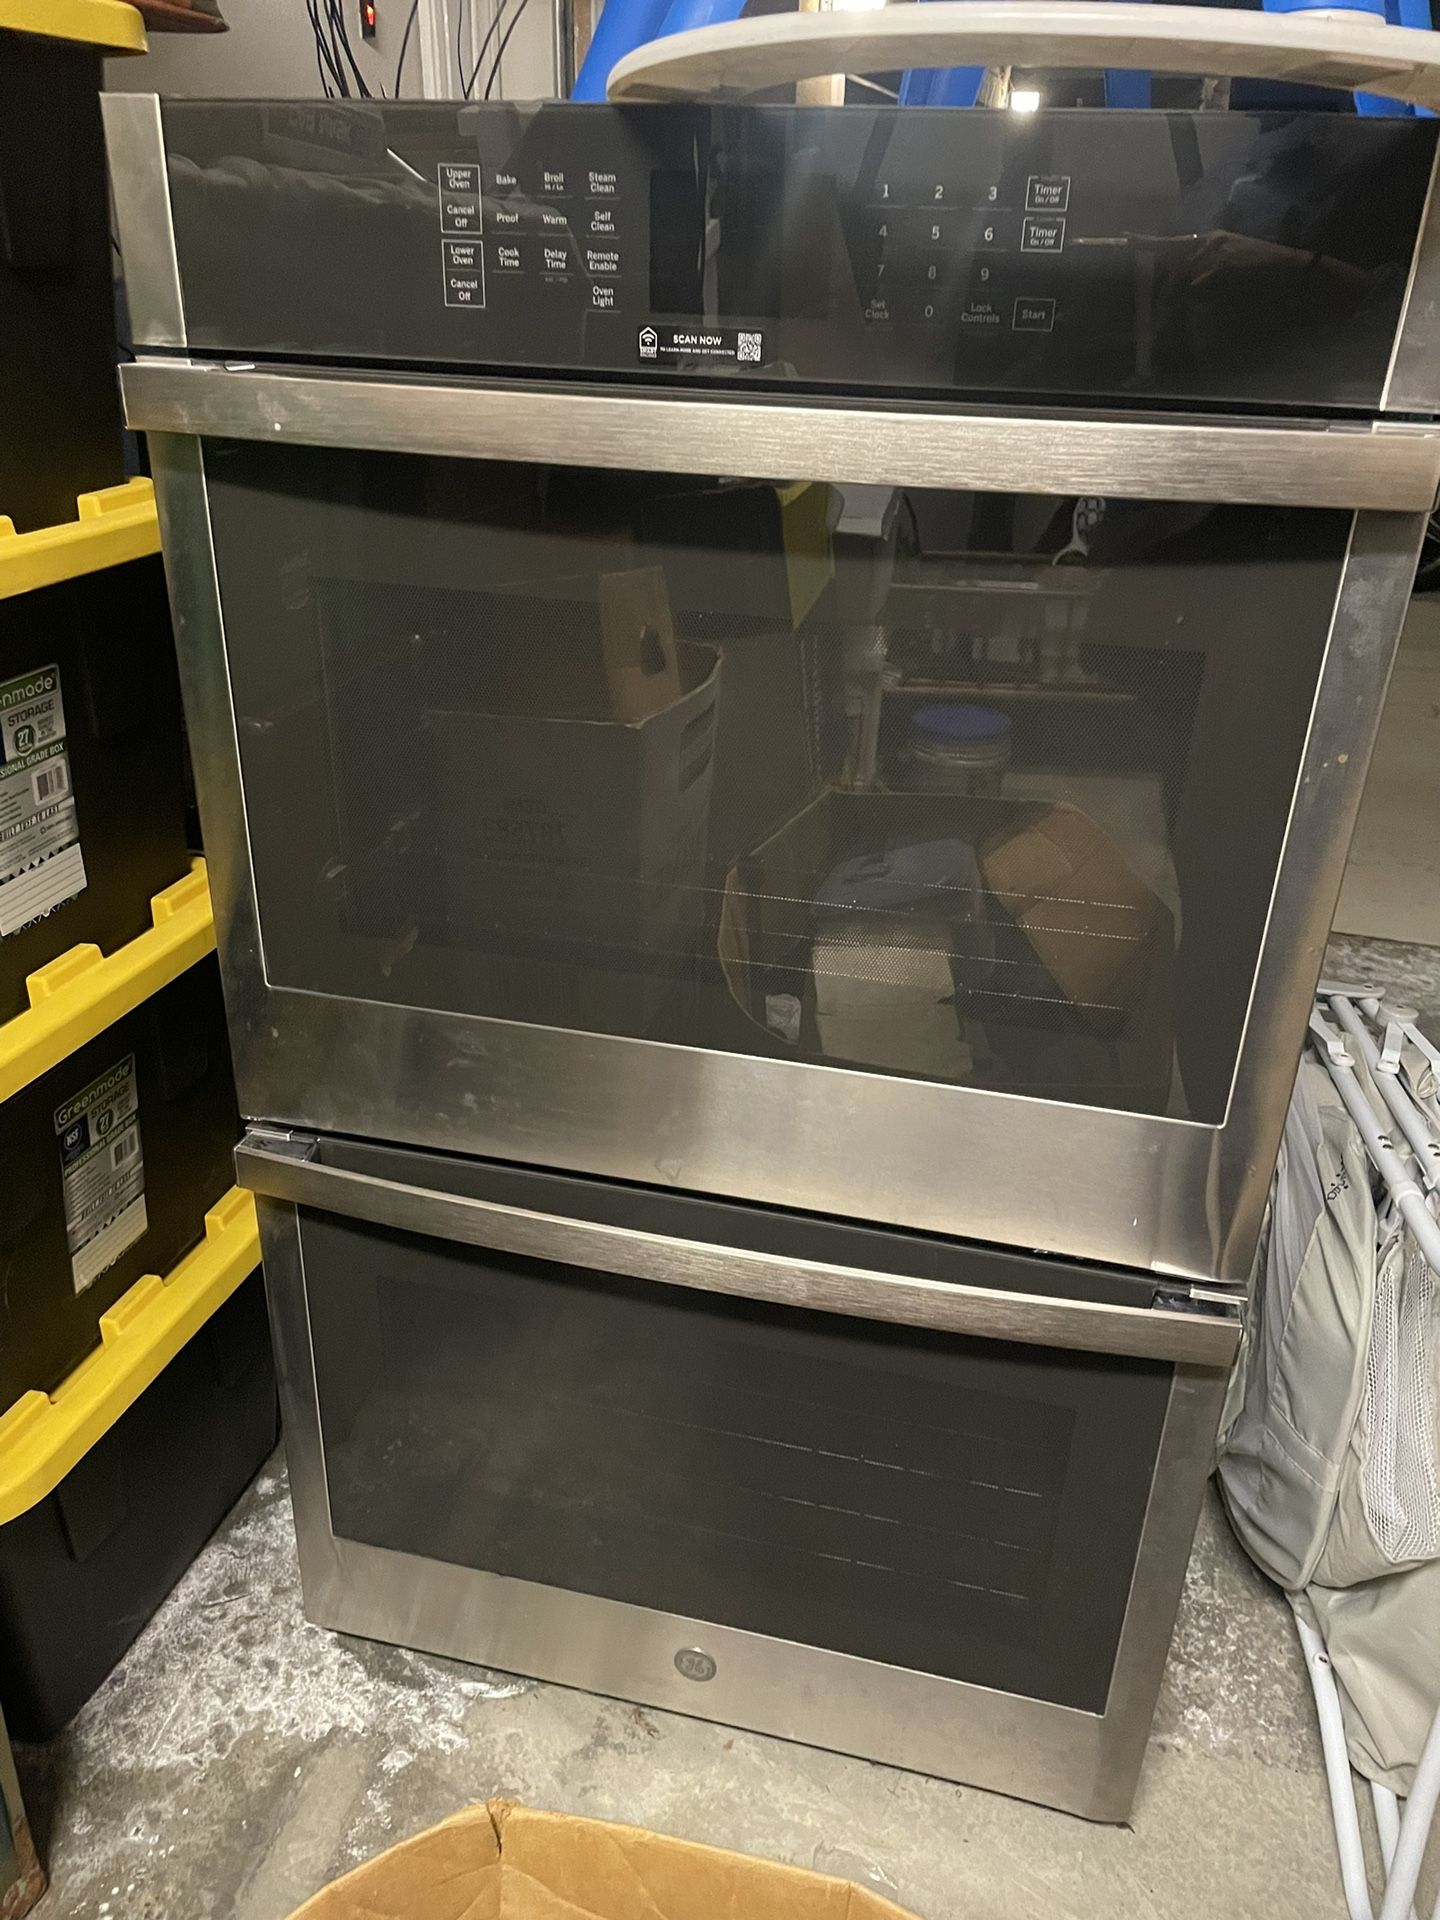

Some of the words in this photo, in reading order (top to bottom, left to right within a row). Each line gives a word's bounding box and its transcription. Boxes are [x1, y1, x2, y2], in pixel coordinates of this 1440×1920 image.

[446, 168, 471, 179] Upper
[496, 174, 517, 184] Bake
[544, 172, 564, 183] Broil
[588, 172, 616, 182] Steam
[449, 180, 470, 189] Oven
[590, 183, 615, 193] Clean
[1034, 184, 1062, 195] Timer
[882, 184, 890, 198] 1
[935, 185, 944, 199] 2
[988, 186, 998, 200] 3
[447, 205, 474, 216] Cancel
[496, 213, 519, 224] Proof
[542, 214, 567, 225] Warm
[594, 212, 611, 221] Self
[455, 218, 468, 228] Off
[591, 222, 615, 232] Clean
[879, 225, 888, 236] 4
[932, 226, 940, 240] 5
[984, 227, 994, 240] 6
[1030, 226, 1058, 237] Timer
[450, 246, 474, 255] Lower
[498, 247, 519, 257] Cook
[544, 249, 567, 260] Delay
[587, 251, 619, 261] Remote
[453, 256, 474, 265] Oven
[500, 257, 519, 267] Time
[546, 259, 566, 269] Time
[590, 262, 617, 271] Enable
[877, 265, 885, 276] 7
[928, 266, 937, 279] 8
[980, 268, 990, 281] 9
[450, 279, 478, 290] Cancel
[458, 291, 472, 301] Off
[593, 286, 614, 296] Oven
[593, 296, 614, 307] Light
[870, 298, 885, 309] Set
[970, 302, 992, 312] Lock
[865, 308, 889, 320] Clock
[924, 305, 934, 318] 0
[1022, 309, 1046, 320] Start
[961, 312, 1000, 323] Controls
[673, 334, 697, 344] SCAN
[699, 336, 722, 346] NOW
[0, 675, 53, 706] nmade
[8, 700, 55, 728] STORAGE
[18, 727, 30, 746] 27
[26, 748, 49, 769] GRADE
[58, 1064, 130, 1124] Greenmade
[91, 1082, 130, 1120] STORAGE
[100, 1114, 110, 1130] 27
[66, 1126, 80, 1144] NSF
